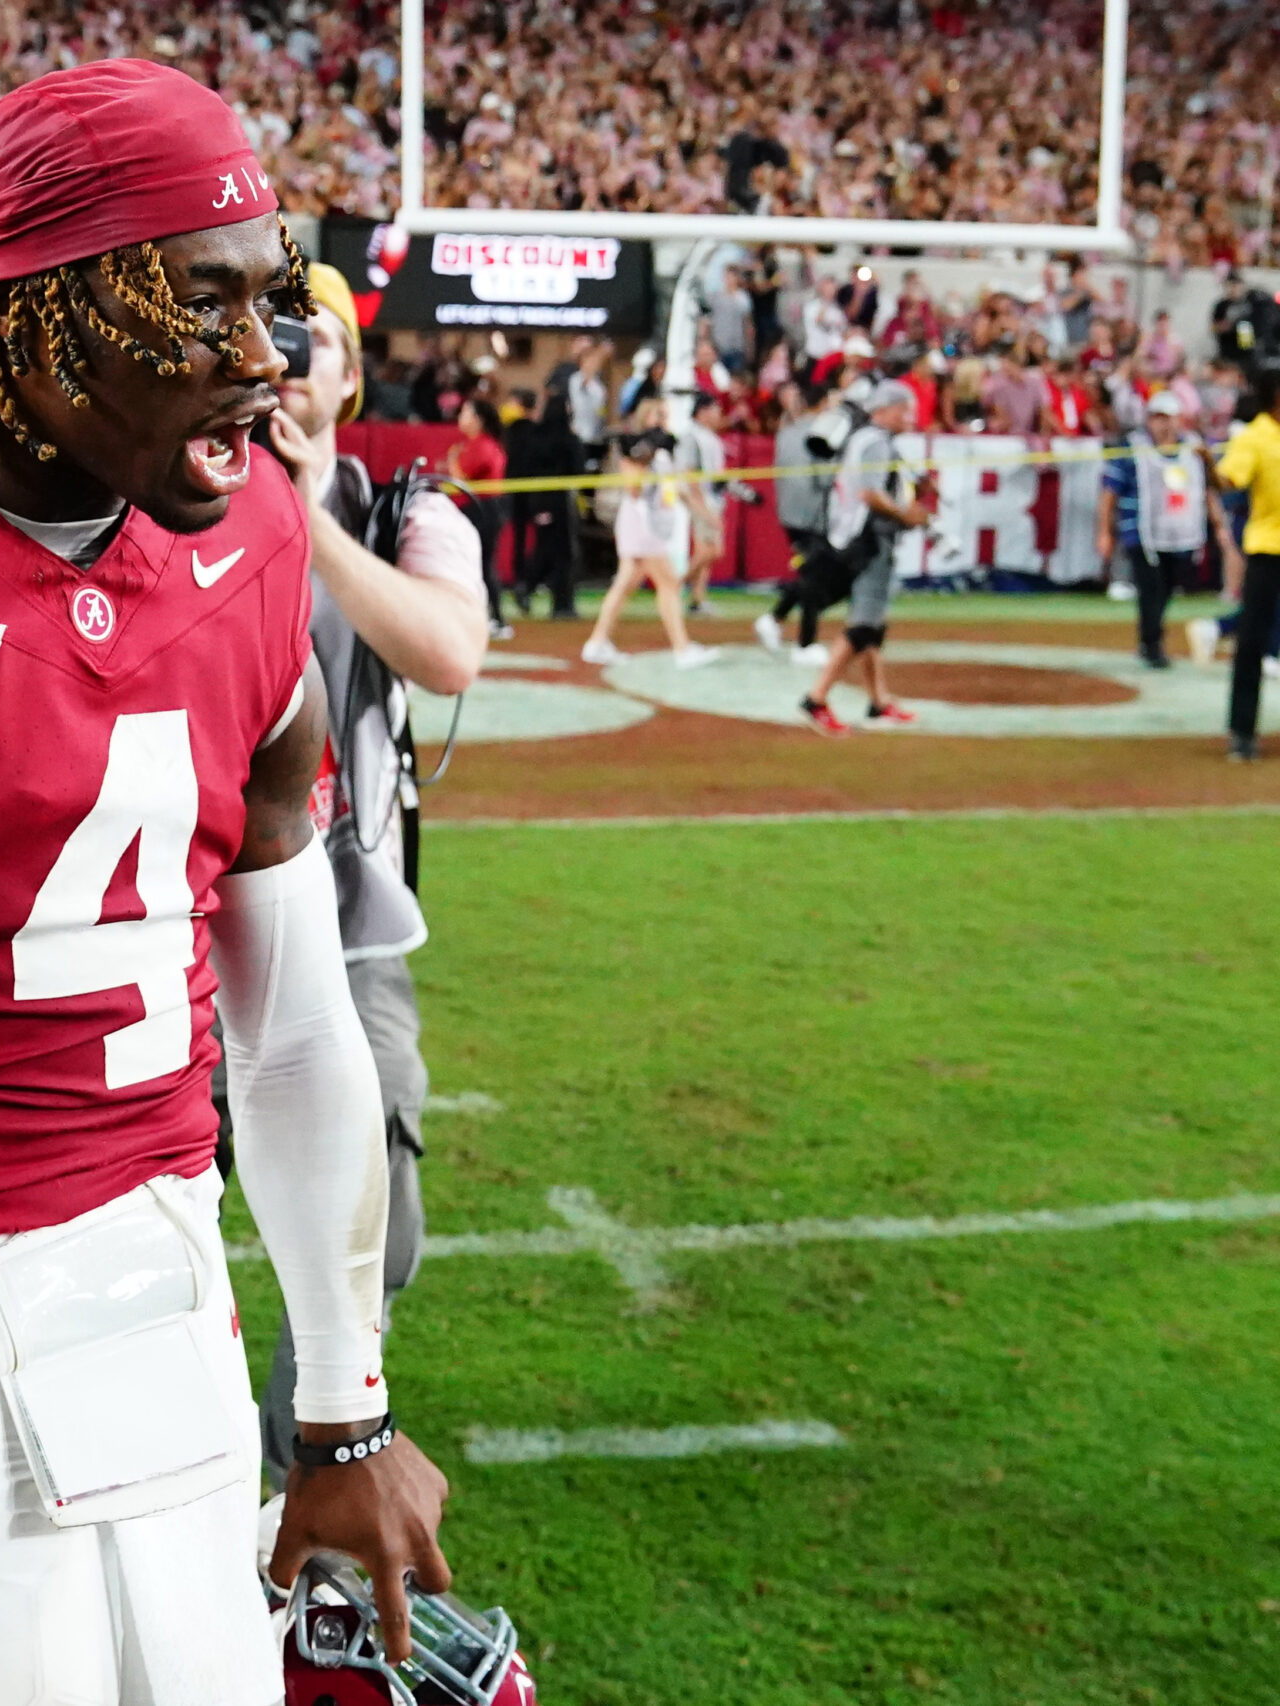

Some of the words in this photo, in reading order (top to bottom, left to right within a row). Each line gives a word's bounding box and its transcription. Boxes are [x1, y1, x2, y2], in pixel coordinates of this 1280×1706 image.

[213, 173, 244, 208] A
[436, 238, 614, 272] DISCOUNT
[81, 595, 106, 630] A
[11, 709, 200, 1090] 4
